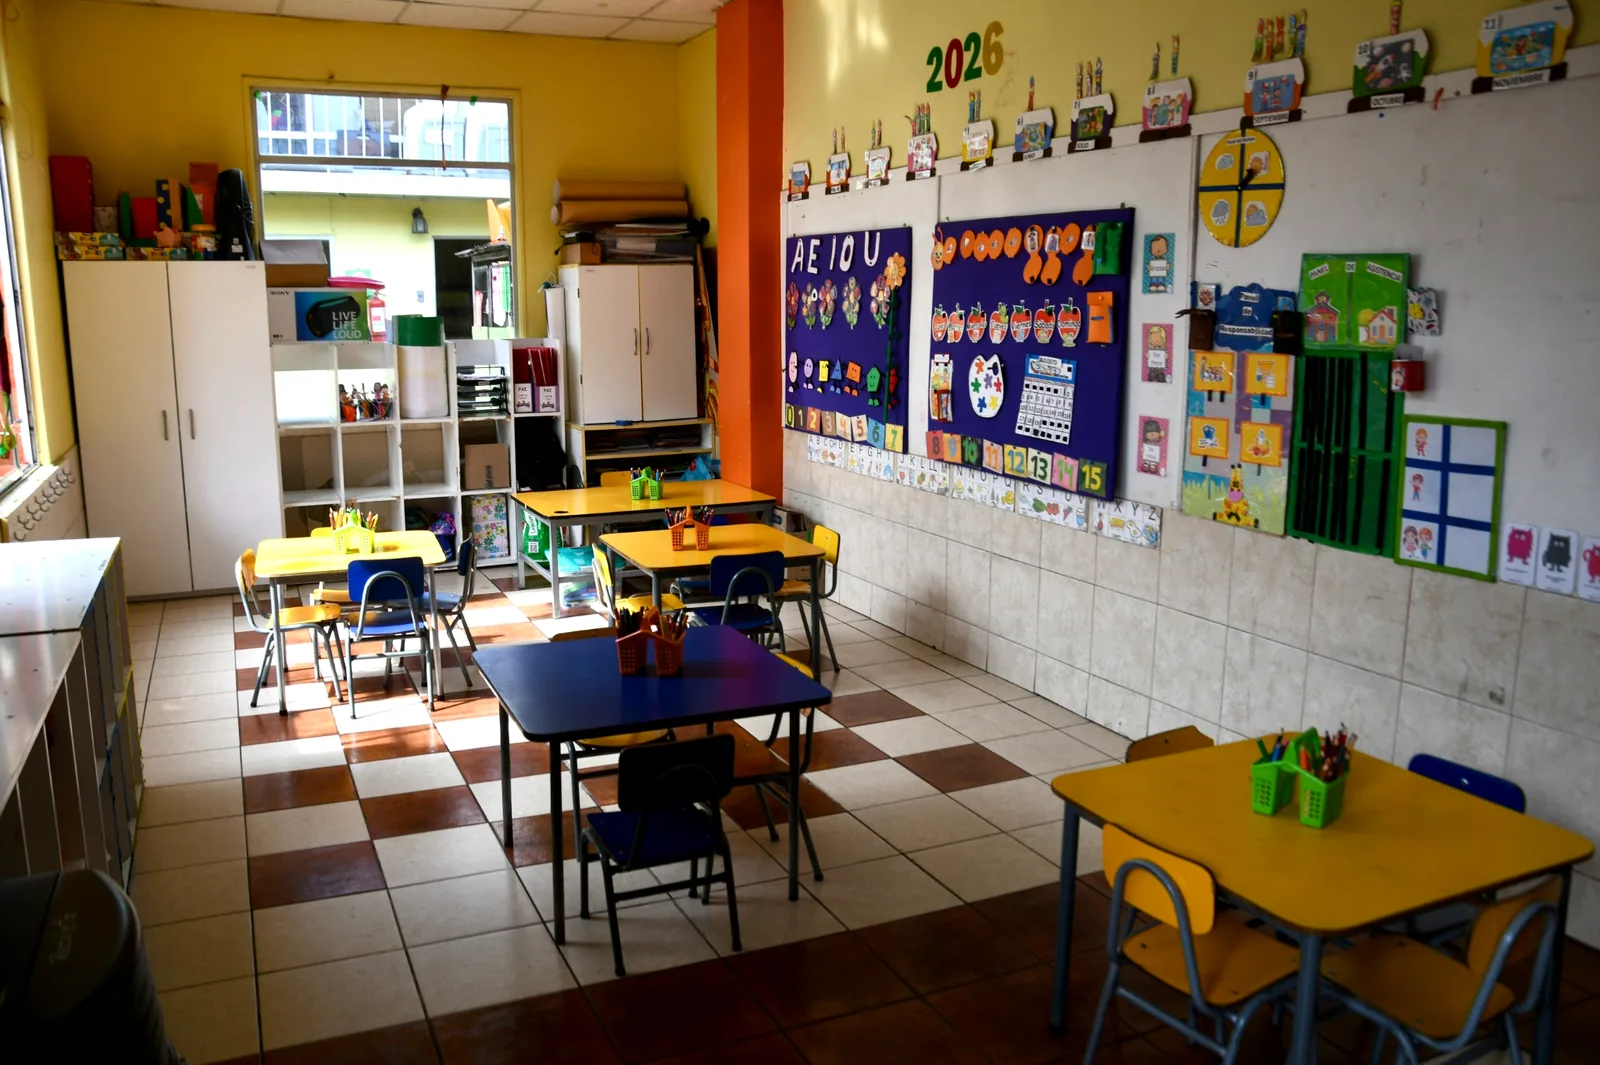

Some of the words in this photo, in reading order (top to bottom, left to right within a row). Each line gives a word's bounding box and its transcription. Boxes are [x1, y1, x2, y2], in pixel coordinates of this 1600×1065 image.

[1357, 44, 1370, 55] 10
[926, 21, 1004, 93] 2026
[1248, 72, 1254, 80] 9
[1494, 73, 1545, 87] NOVIEMBRE
[1373, 97, 1403, 106] OCTUBRE
[1254, 112, 1289, 124] SEPTIEMBRE
[1310, 265, 1328, 279] PANEL
[1347, 263, 1355, 271] DE
[1368, 264, 1401, 280] ASISTENCIA
[1240, 292, 1258, 301] Panel
[332, 311, 357, 320] LIVE
[333, 321, 357, 329] LIFE
[1011, 321, 1032, 330] Viernes
[1057, 320, 1081, 330] Domingo
[1220, 324, 1273, 336] Responsabilidad
[333, 330, 361, 339] LOUD
[787, 405, 793, 426] 0
[798, 409, 804, 427] 1
[810, 411, 817, 429] 2
[826, 413, 833, 433] 3
[840, 416, 848, 436] 4
[856, 419, 864, 439] 5
[872, 425, 880, 443] 6
[890, 429, 898, 449] 7
[816, 436, 821, 445] B
[824, 437, 828, 447] C
[850, 442, 855, 453] E
[867, 446, 873, 457] G
[876, 448, 882, 459] H
[909, 456, 915, 467] K
[920, 458, 925, 469] L
[932, 435, 940, 455] 8
[948, 437, 957, 458] 9
[963, 439, 979, 465] 10
[986, 445, 999, 471] 11
[1008, 450, 1024, 474] 12
[1031, 455, 1048, 481] 13
[1057, 460, 1074, 488] 14
[1081, 464, 1103, 491] 15
[956, 465, 963, 476] N
[1114, 497, 1122, 513] X
[1131, 502, 1140, 516] Y
[1148, 506, 1157, 521] Z
